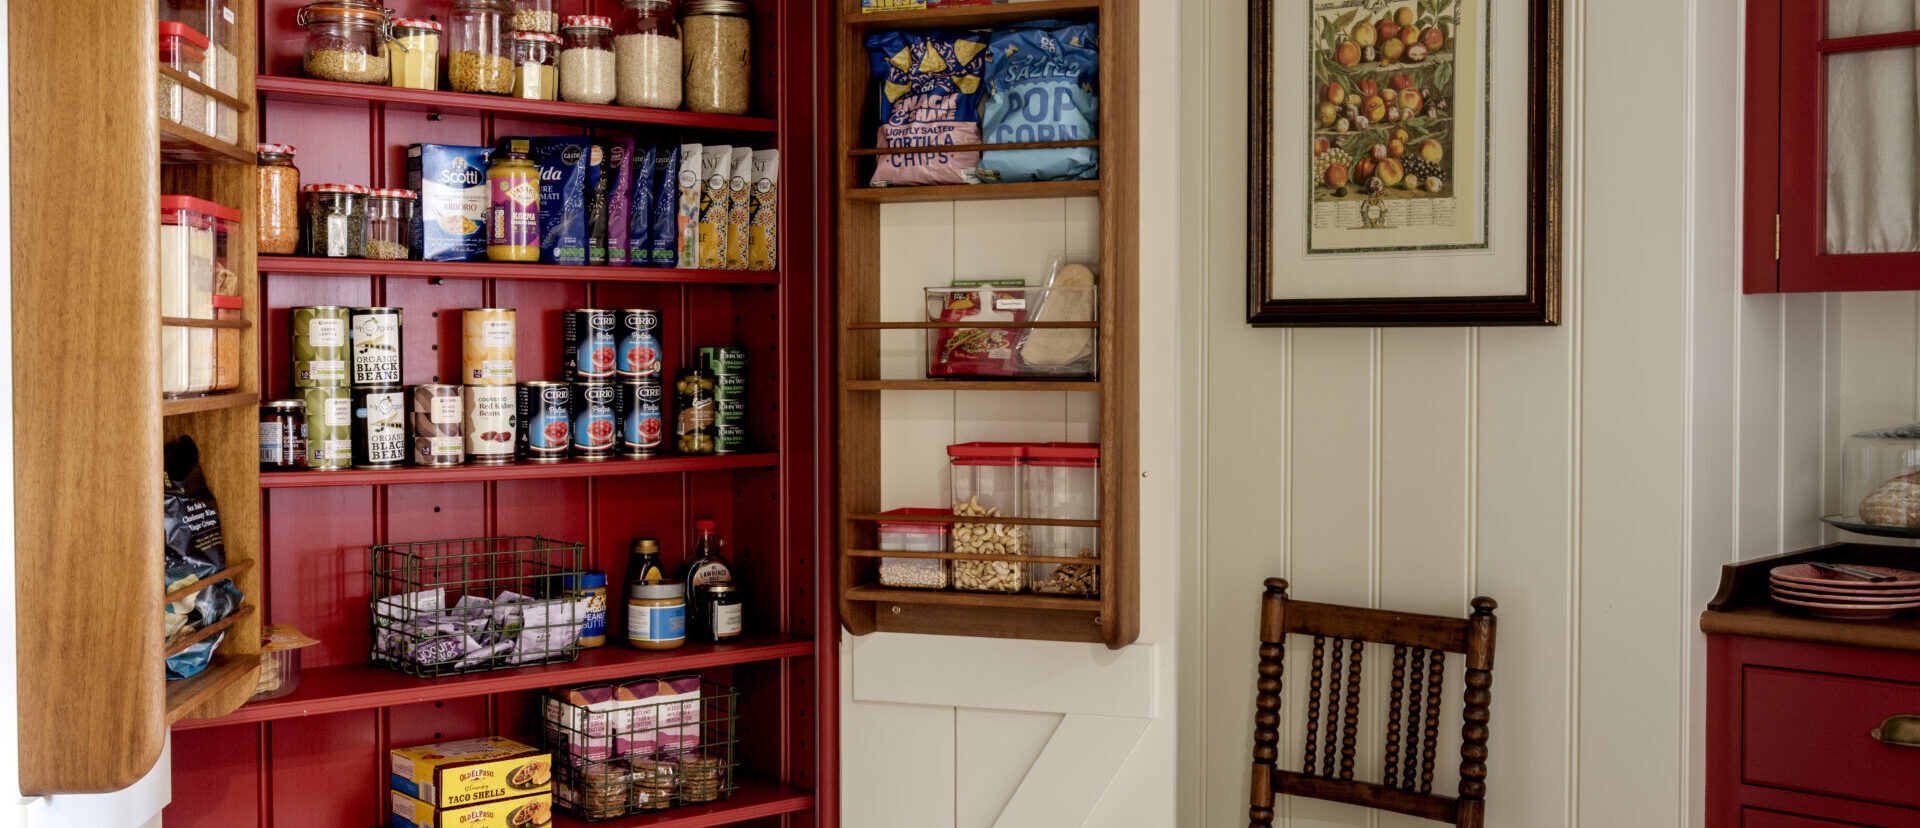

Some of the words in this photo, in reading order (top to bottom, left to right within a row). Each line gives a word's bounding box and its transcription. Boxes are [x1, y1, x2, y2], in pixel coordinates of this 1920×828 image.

[892, 93, 959, 113] SNACK
[1006, 86, 1078, 124] POP
[888, 109, 908, 127] &
[908, 108, 956, 122] SHARE
[885, 127, 920, 137] LIGHTLY
[921, 125, 954, 135] SALTED
[996, 122, 1079, 146] CORN
[886, 133, 954, 149] TORTILLA
[891, 152, 949, 168] CHIPS
[441, 169, 478, 184] Scotti
[444, 203, 477, 212] ARBORIO
[594, 317, 615, 325] CIRIO
[628, 317, 655, 325] CIRIO
[356, 355, 398, 363] ORGANIC
[356, 363, 398, 372] BLACK
[357, 371, 398, 381] BEANS
[544, 391, 568, 399] CIRIO
[588, 391, 613, 399] CIRIO
[449, 793, 471, 805] TACO
[473, 787, 506, 801] SHELLS
